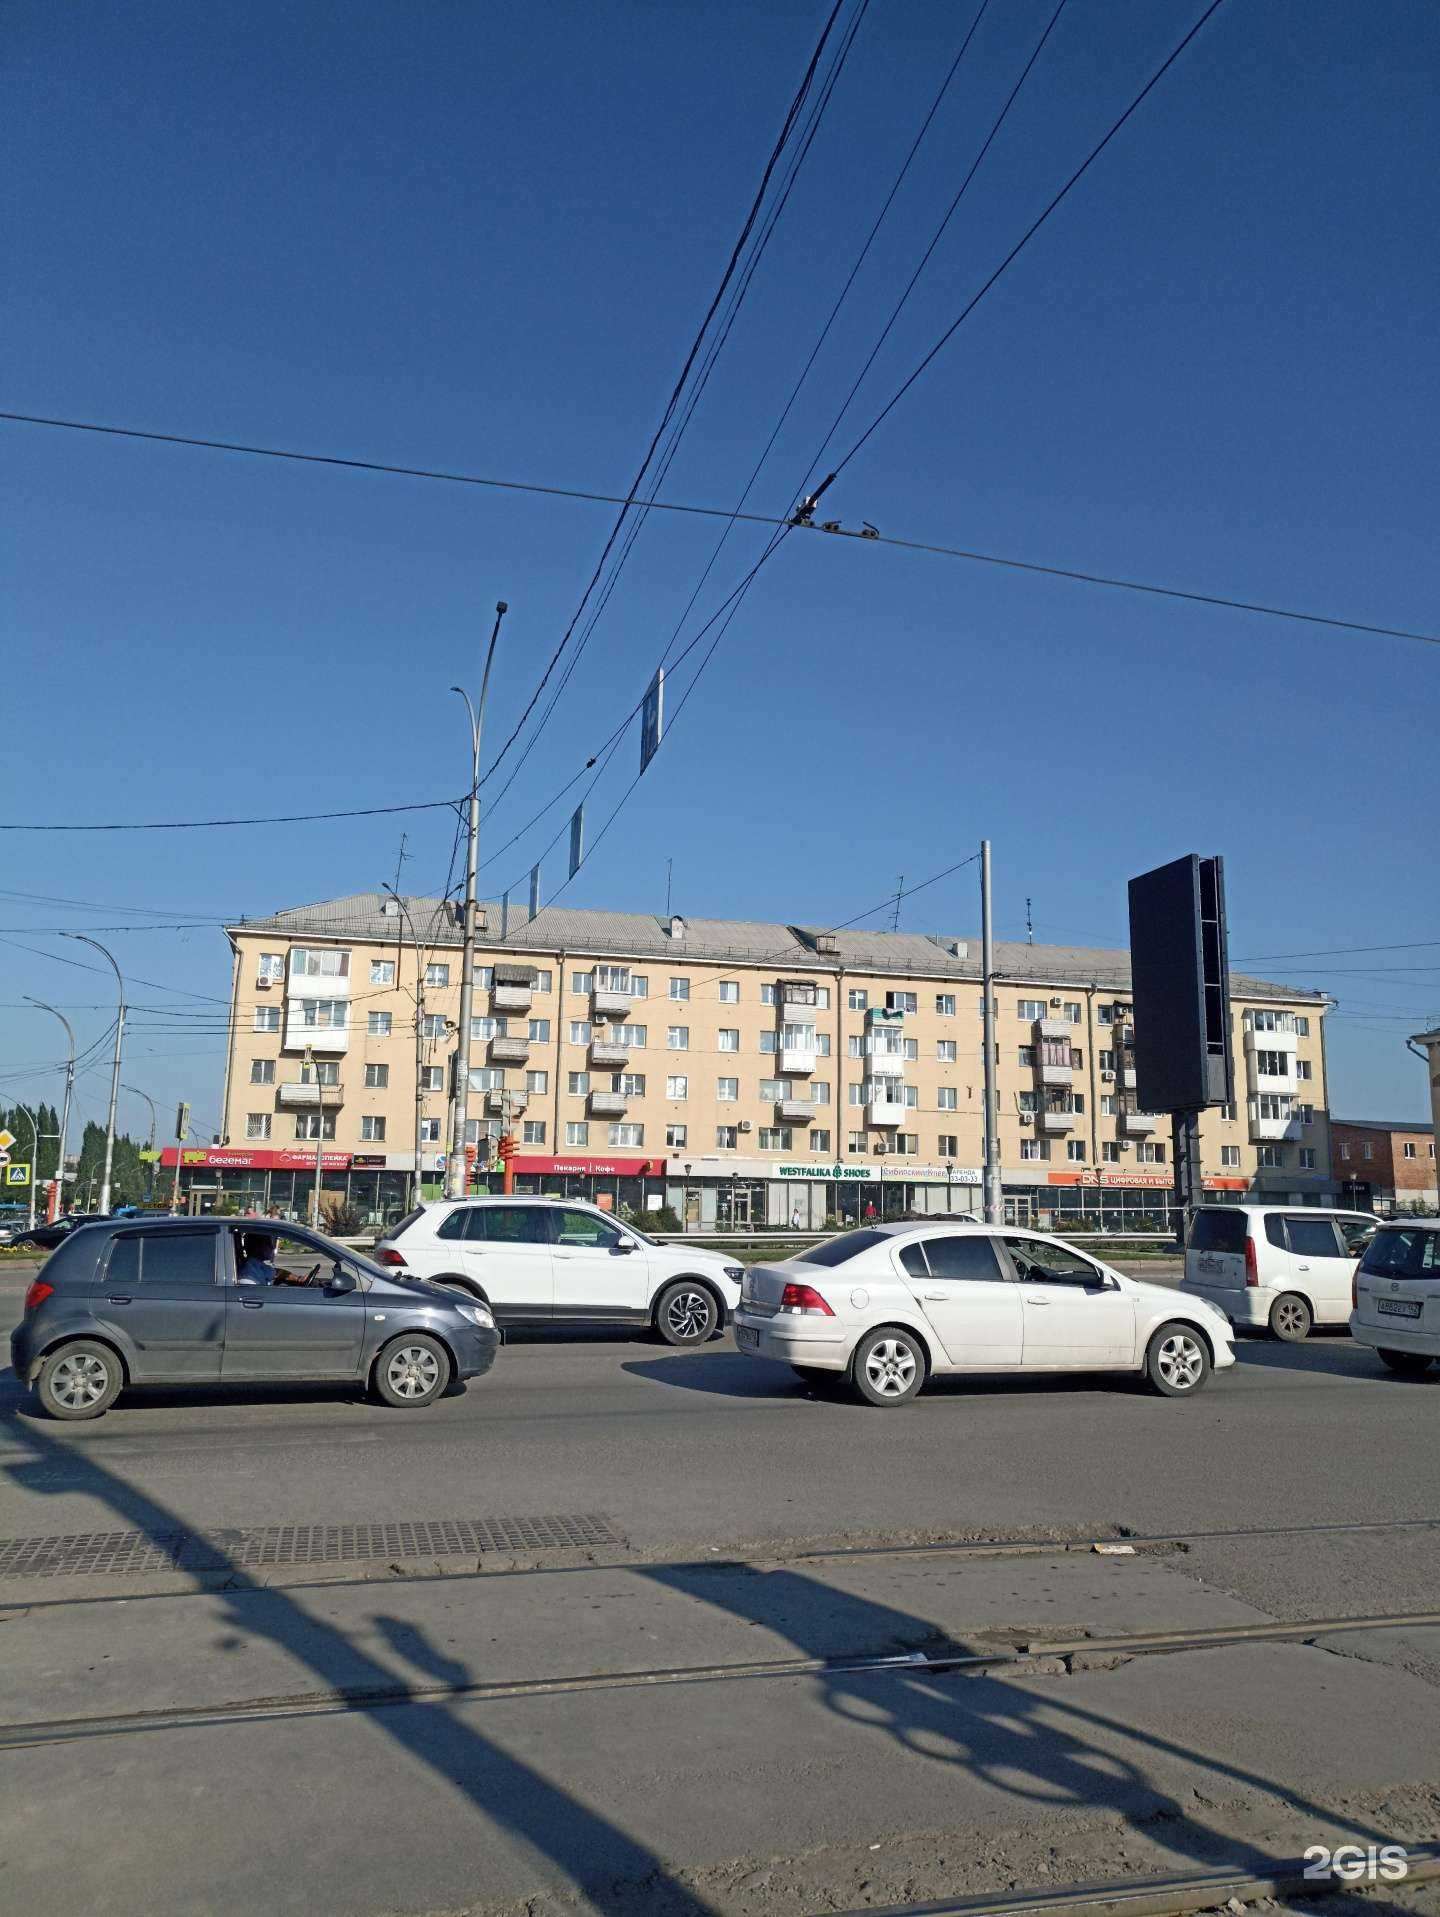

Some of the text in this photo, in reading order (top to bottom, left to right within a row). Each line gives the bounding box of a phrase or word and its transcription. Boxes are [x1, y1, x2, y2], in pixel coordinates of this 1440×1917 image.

[554, 1164, 615, 1173] Пекарня Кофе
[779, 1166, 871, 1178] WESTFALIKA SHOES
[1082, 1175, 1109, 1184] DNS
[1110, 1176, 1147, 1184] ЦИФРОВАЯ
